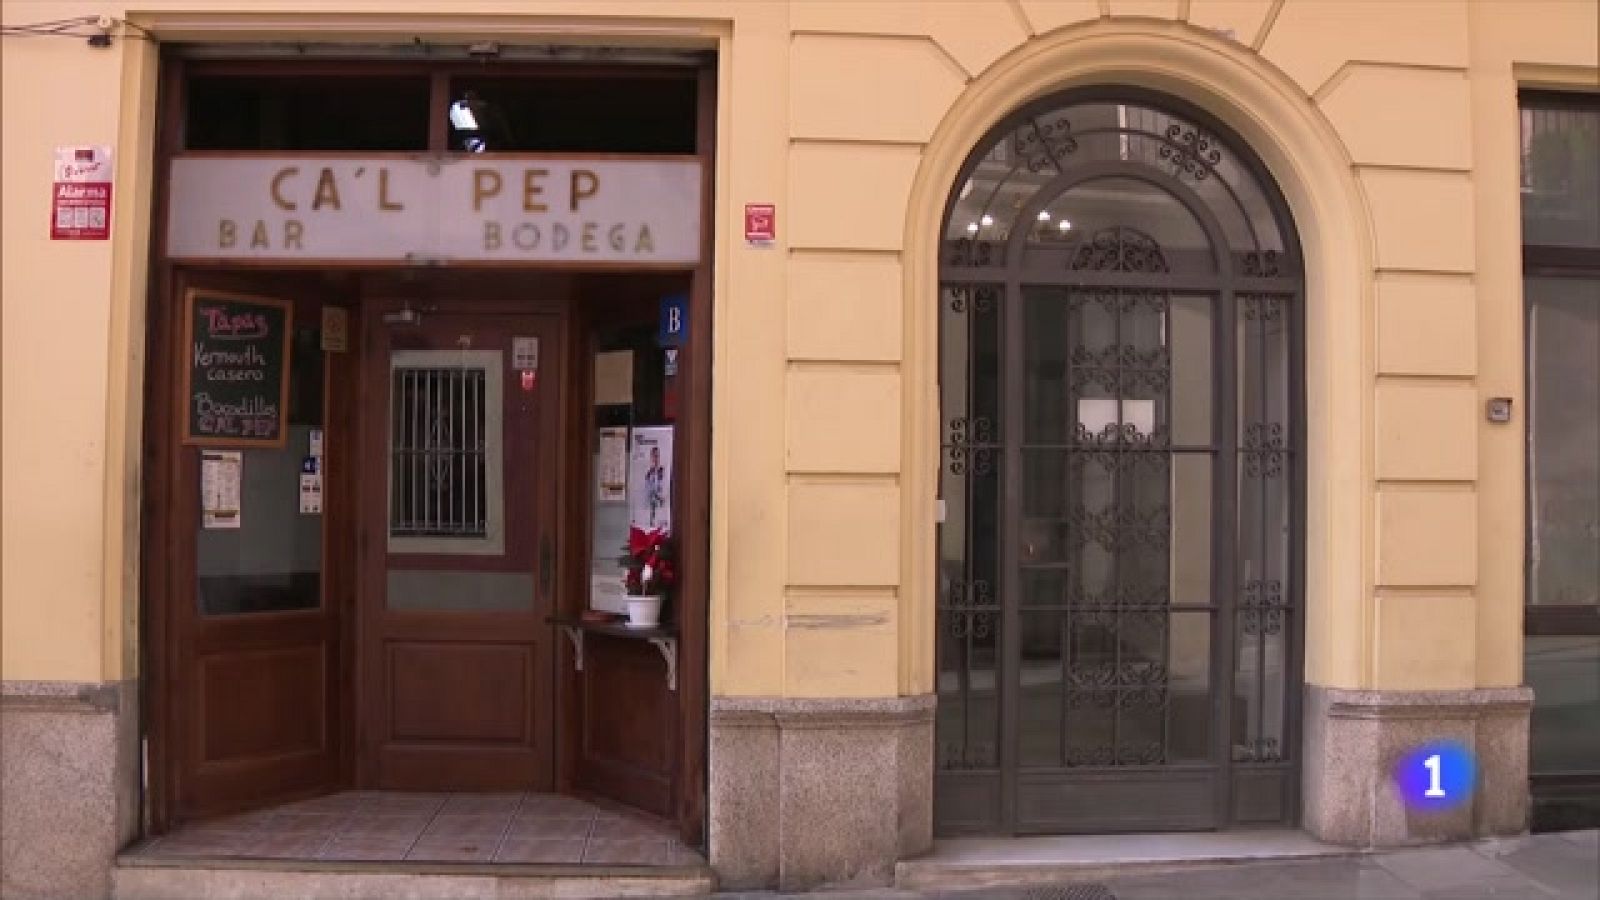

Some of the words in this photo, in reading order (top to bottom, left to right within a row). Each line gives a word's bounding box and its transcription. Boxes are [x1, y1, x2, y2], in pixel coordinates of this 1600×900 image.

[472, 168, 601, 212] PEP
[218, 219, 305, 250] BAR
[483, 221, 656, 254] BODEGA
[200, 305, 269, 337] Tapas
[669, 306, 681, 333] B
